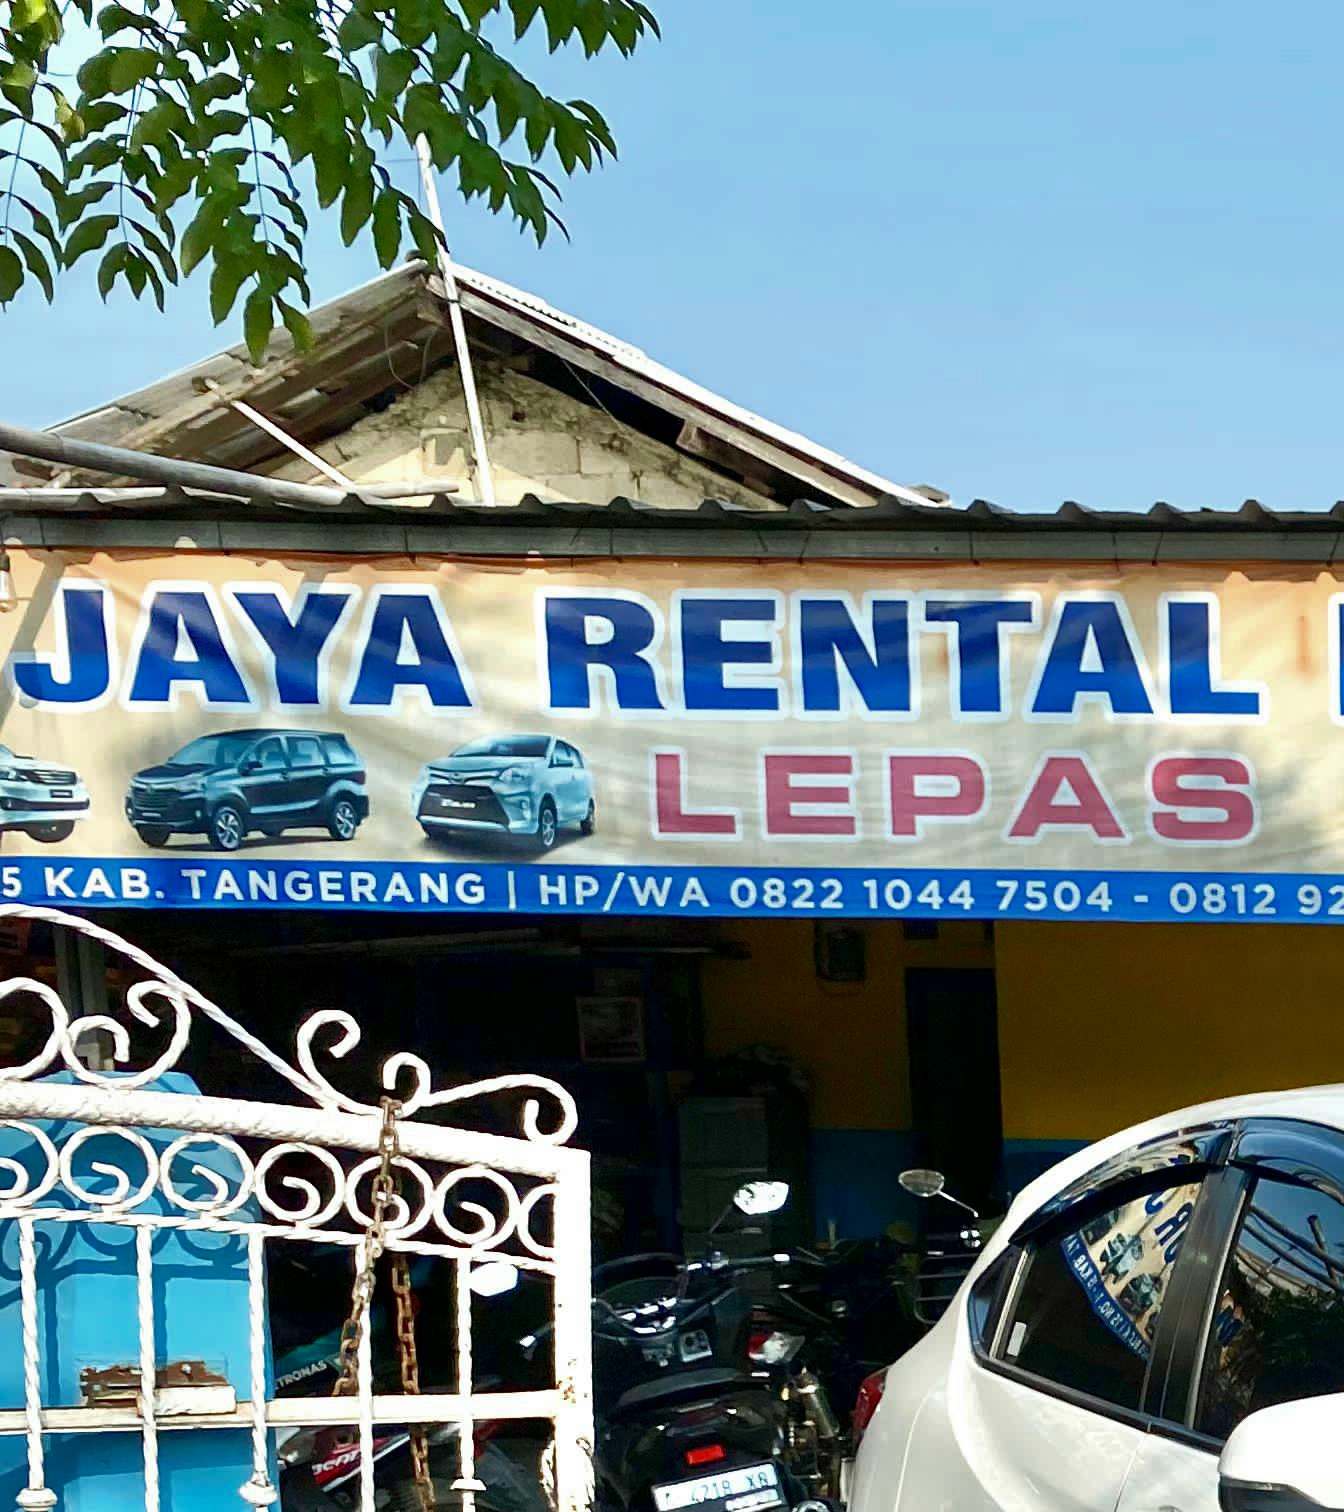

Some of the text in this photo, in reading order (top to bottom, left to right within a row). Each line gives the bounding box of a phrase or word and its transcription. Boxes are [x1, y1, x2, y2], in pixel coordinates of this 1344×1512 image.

[14, 588, 473, 707] JAYA
[545, 597, 1260, 715] RENTAL
[655, 754, 1253, 840] LEPAS
[44, 866, 164, 899] KAB.
[181, 868, 486, 904] TANGERANG
[539, 871, 709, 912] HP/WA
[730, 877, 843, 909] 0822
[862, 879, 975, 910] 1044
[996, 880, 1112, 912] 7504
[1170, 882, 1276, 914] 0812
